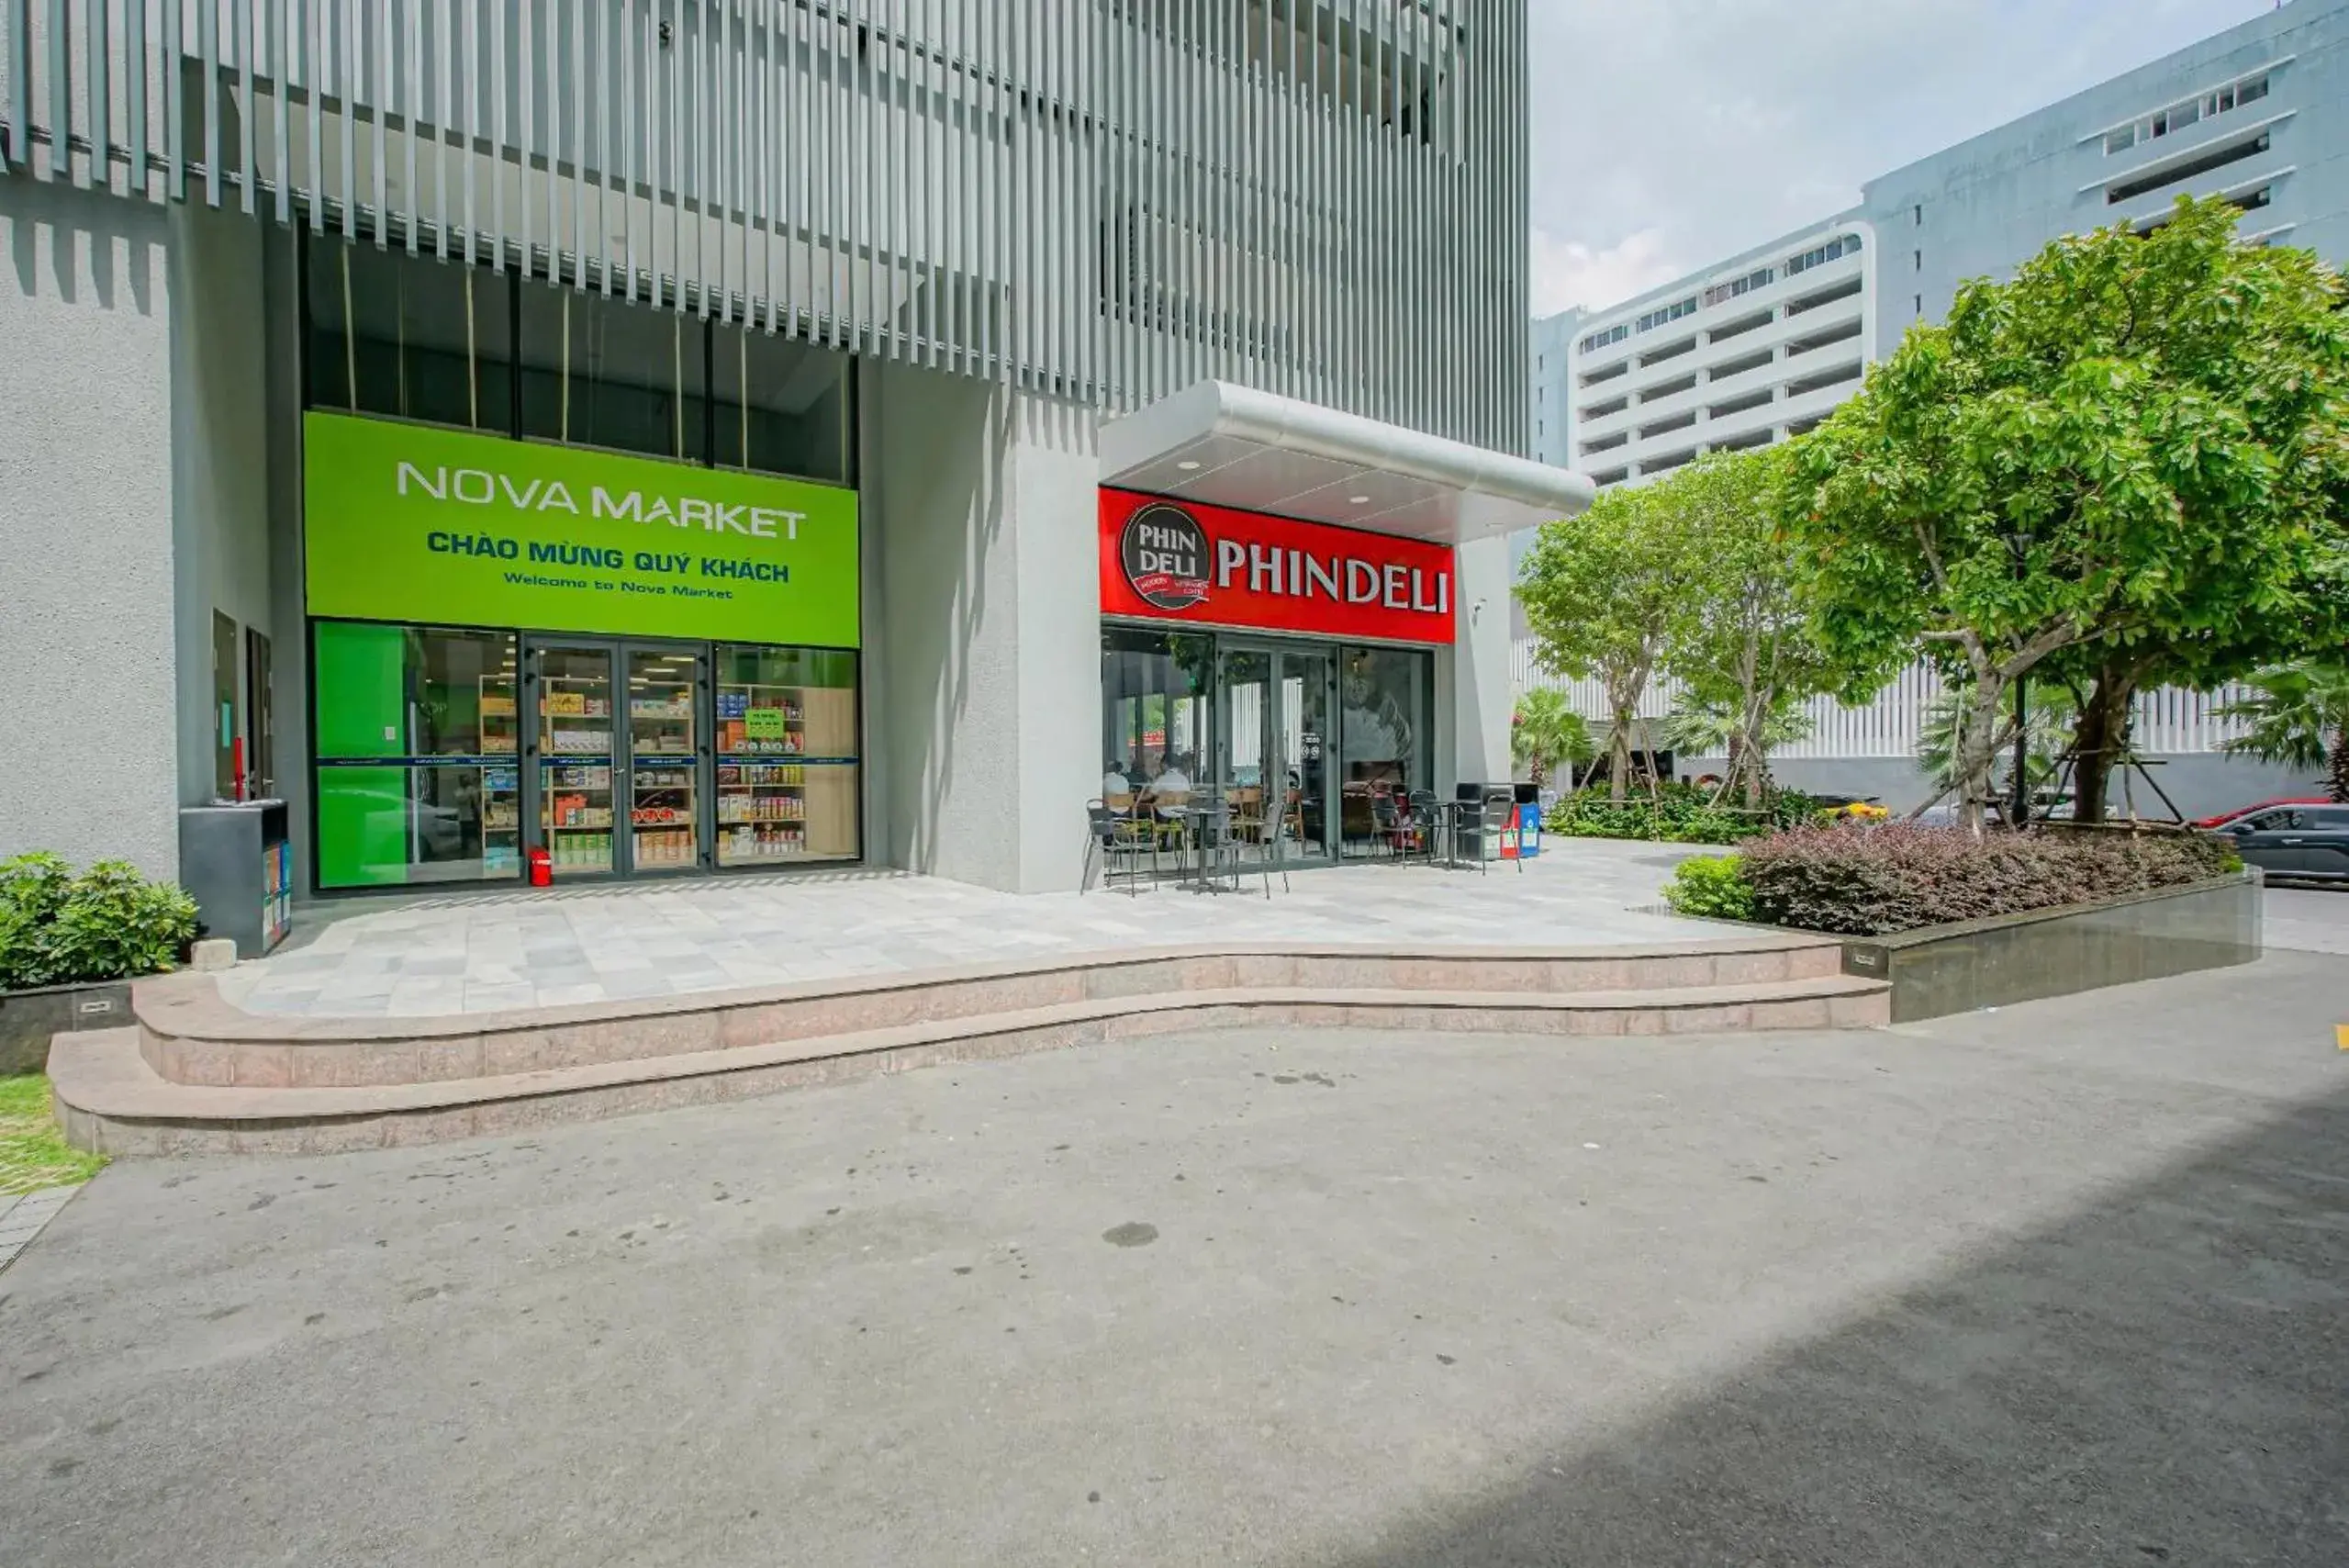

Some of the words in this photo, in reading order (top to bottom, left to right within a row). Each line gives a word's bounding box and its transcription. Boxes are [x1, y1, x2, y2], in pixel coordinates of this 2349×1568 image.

[397, 462, 579, 514] NOVA
[592, 487, 805, 540] MARKET
[428, 531, 520, 560] CHÀO
[529, 540, 623, 569] MỪNG
[634, 552, 690, 575] QUÝ
[701, 557, 789, 583] KHÁCH
[1139, 524, 1196, 551] PHIN
[1140, 551, 1196, 577] DELI
[1217, 539, 1449, 613] PHINDELI
[504, 573, 587, 588] Welcome
[595, 580, 614, 590] to
[621, 581, 666, 595] Nova
[672, 586, 733, 599] Market
